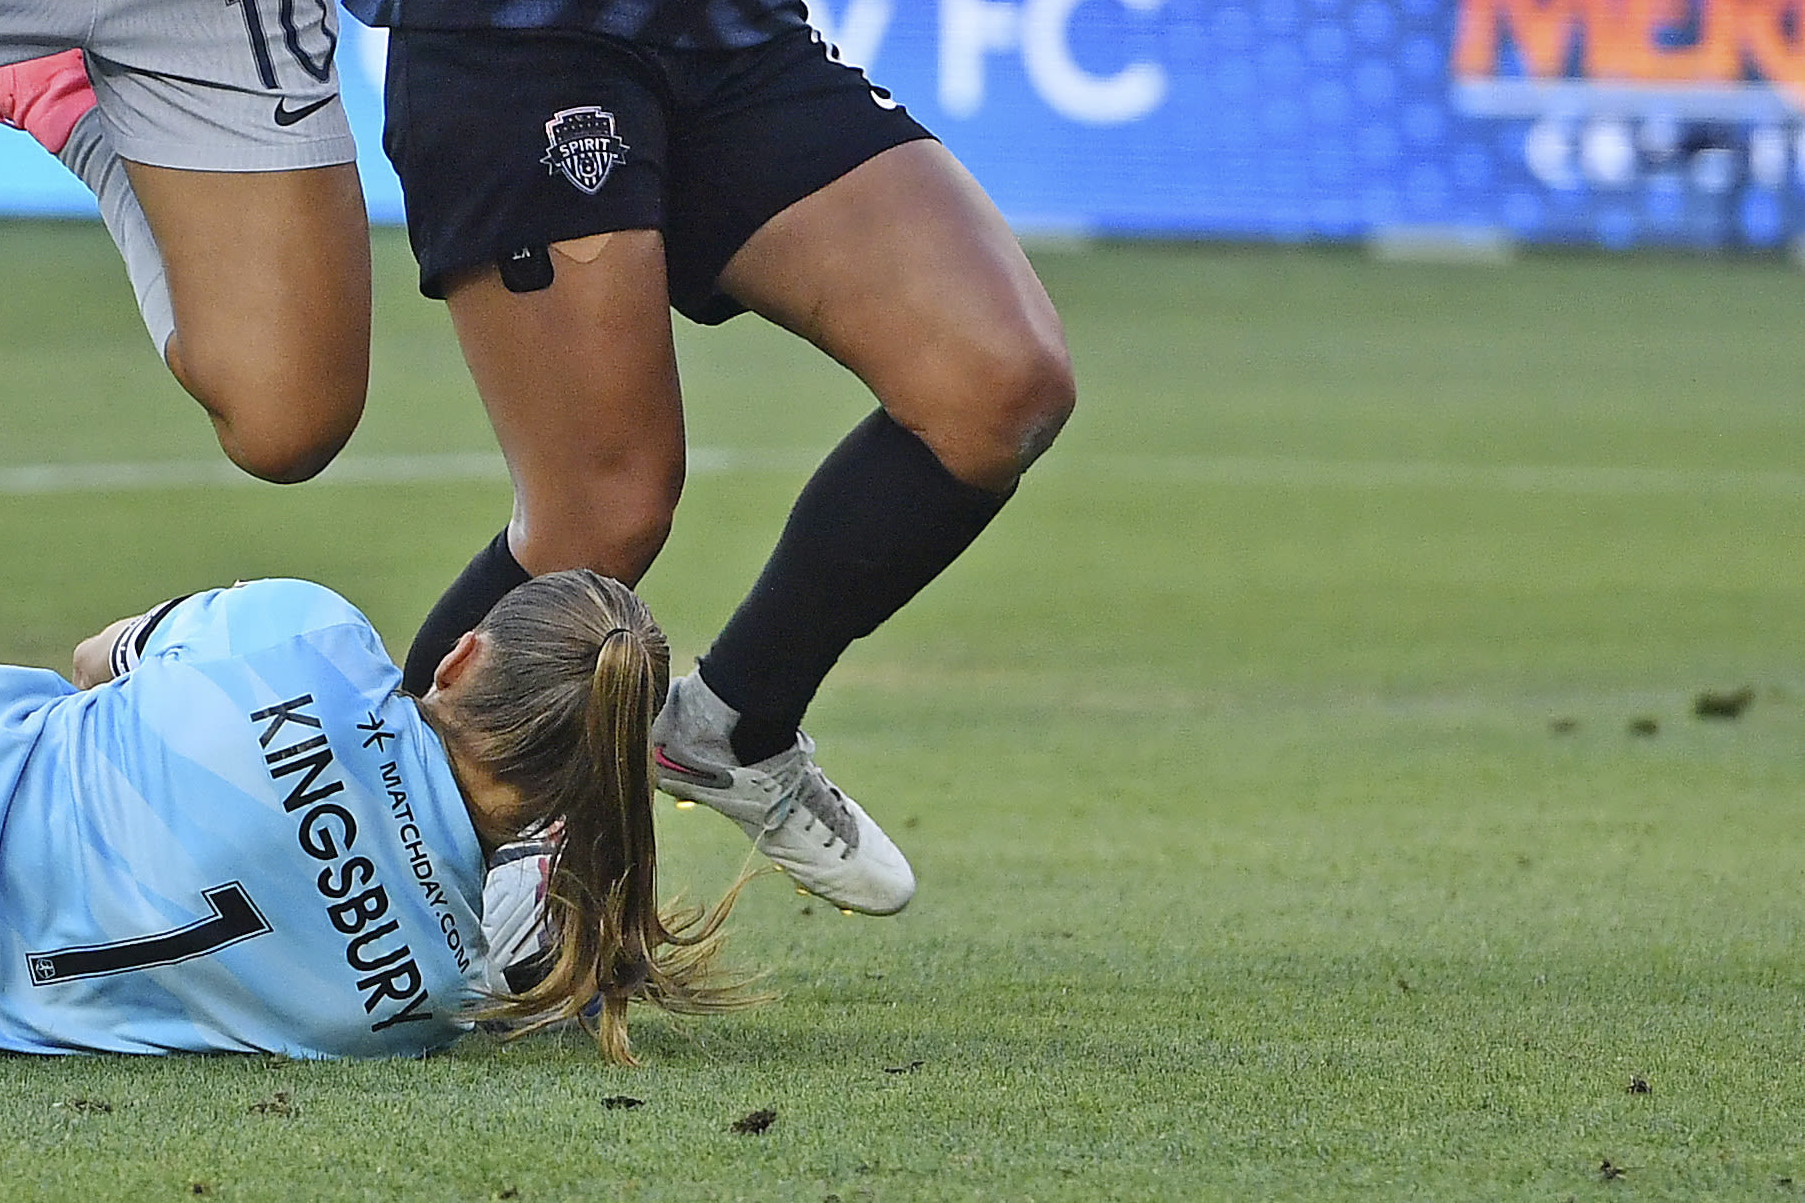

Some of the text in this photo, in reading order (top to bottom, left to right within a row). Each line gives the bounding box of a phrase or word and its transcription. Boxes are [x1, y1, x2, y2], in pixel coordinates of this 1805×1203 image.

[559, 137, 610, 157] SPIRIT
[25, 880, 274, 987] 1
[250, 693, 433, 1032] KINGSBURY
[380, 761, 471, 974] MATCHDAY.COM
